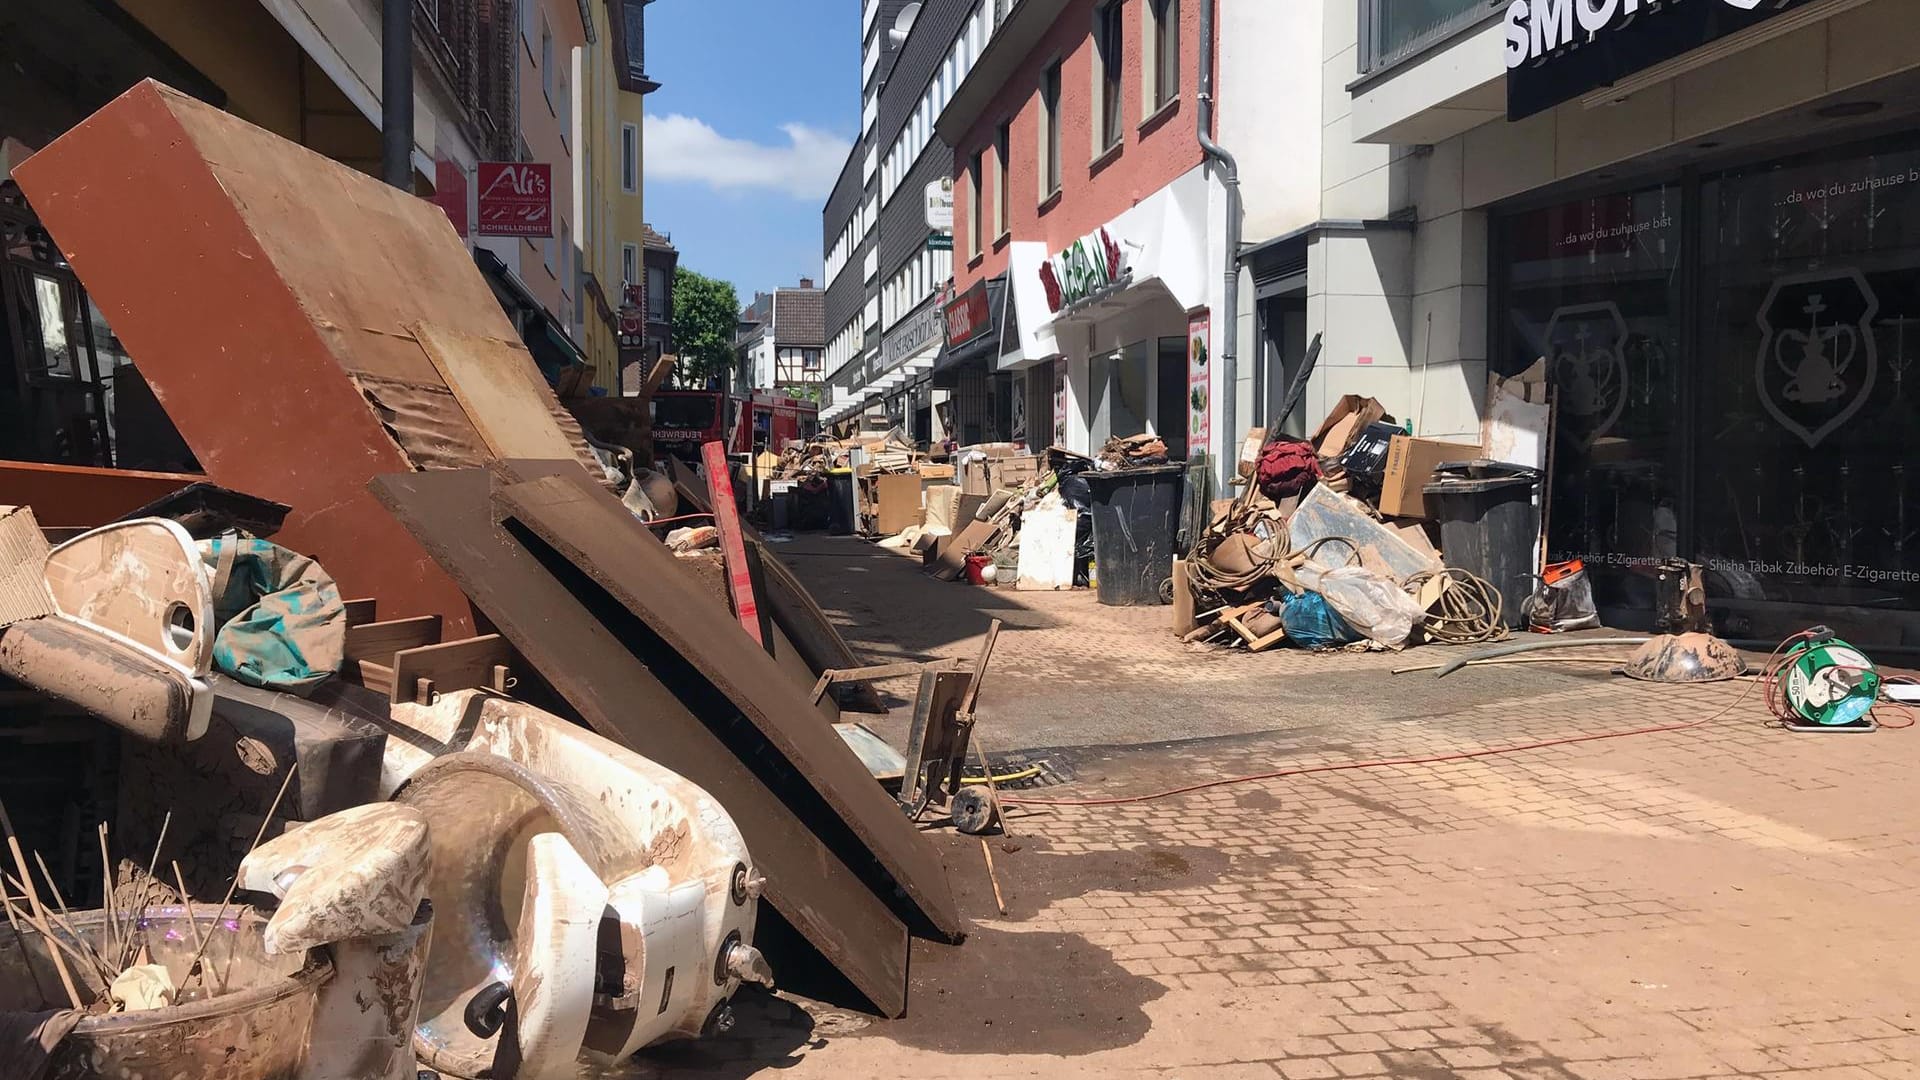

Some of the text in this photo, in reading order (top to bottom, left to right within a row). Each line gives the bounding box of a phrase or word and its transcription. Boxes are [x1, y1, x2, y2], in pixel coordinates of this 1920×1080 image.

[480, 166, 546, 200] Ali's
[1806, 188, 1825, 201] wo
[1829, 182, 1846, 196] du
[1850, 174, 1905, 193] zuhause
[481, 224, 548, 232] SCHNELLDIENST
[1580, 233, 1594, 241] wo
[1595, 226, 1609, 239] du
[1611, 222, 1650, 237] zuhause
[1652, 216, 1672, 229] bist
[1607, 553, 1663, 568] E-Zigarette
[1709, 558, 1920, 583] Shisha Tabak Zubehör E-Zigarette
[1792, 686, 1800, 695] 50
